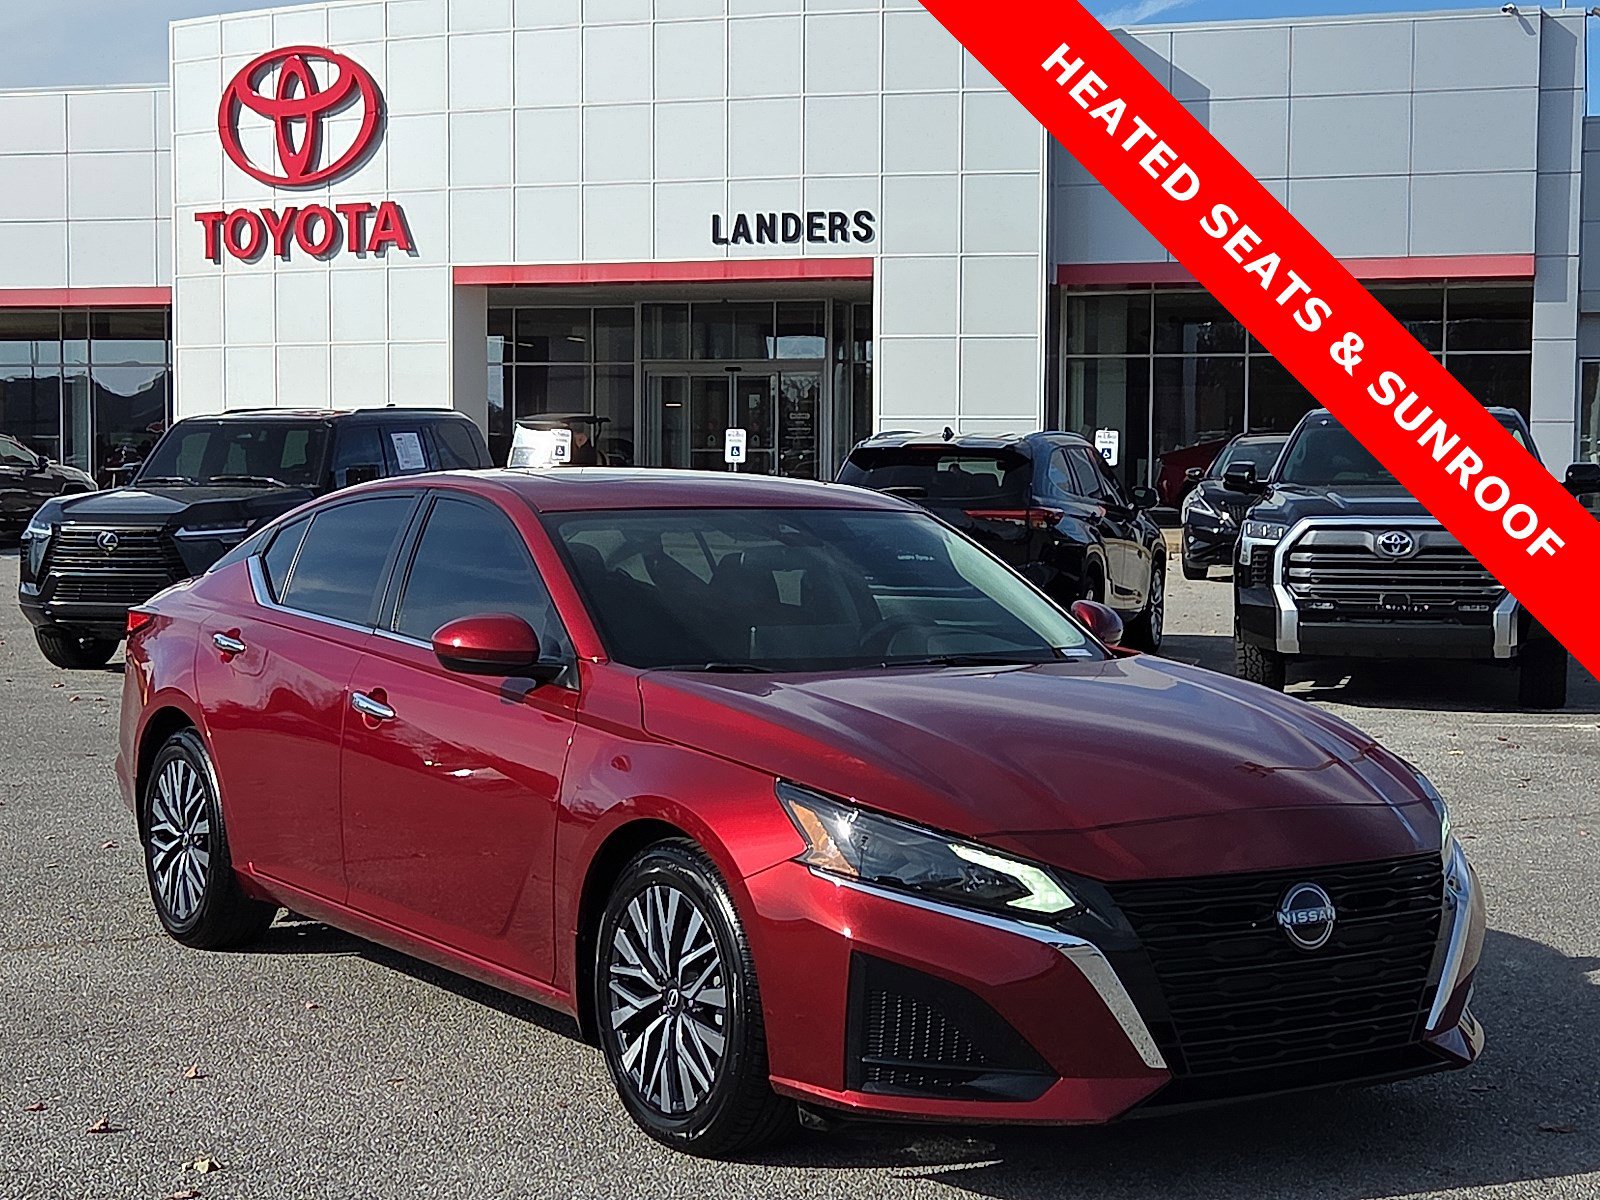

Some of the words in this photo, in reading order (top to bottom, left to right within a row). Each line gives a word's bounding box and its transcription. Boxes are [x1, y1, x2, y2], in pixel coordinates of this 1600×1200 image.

[195, 201, 416, 262] TOYOTA
[712, 211, 875, 245] LANDERS
[1277, 906, 1336, 925] NISSAN
